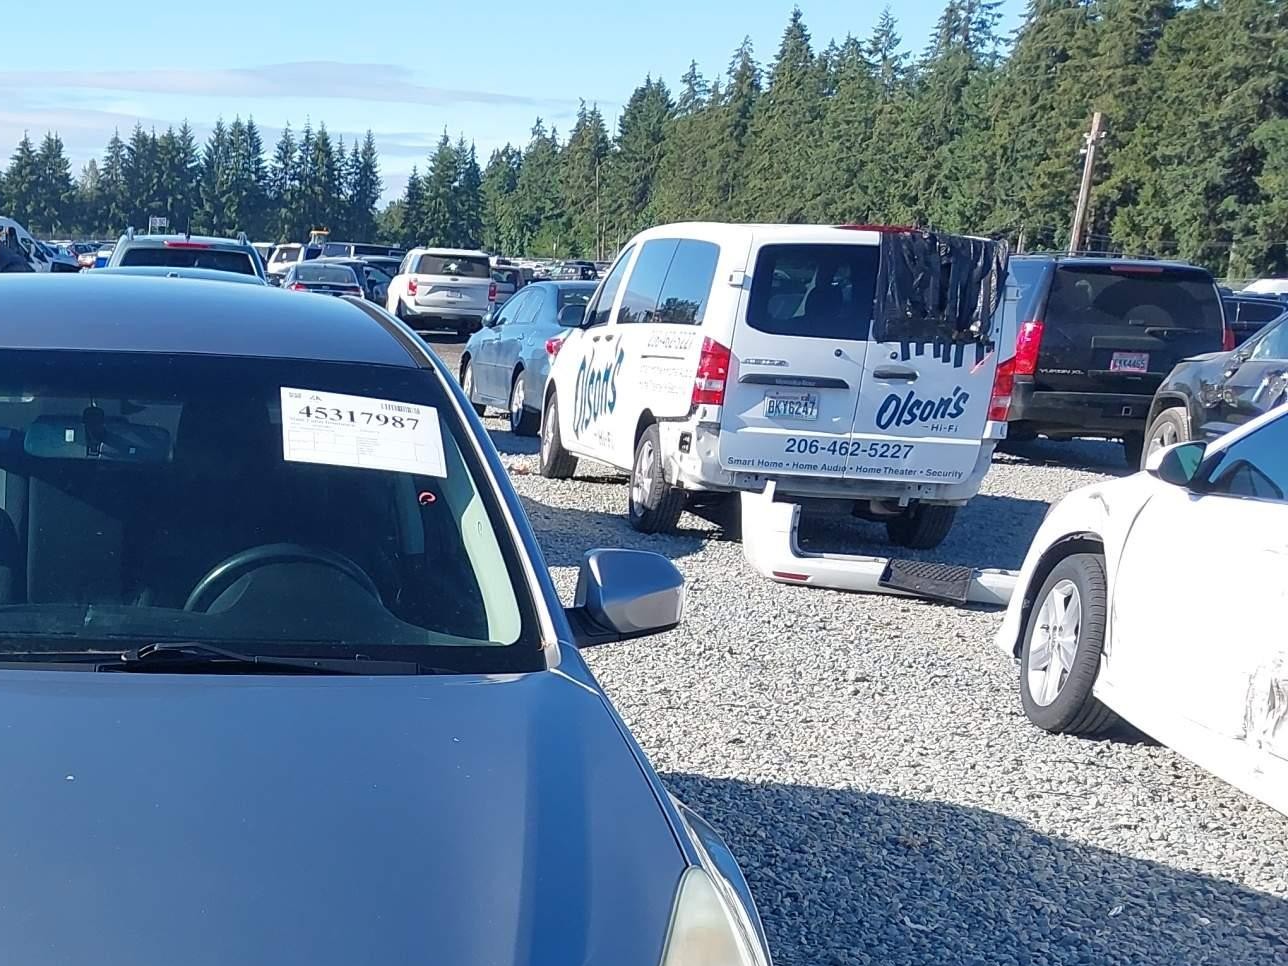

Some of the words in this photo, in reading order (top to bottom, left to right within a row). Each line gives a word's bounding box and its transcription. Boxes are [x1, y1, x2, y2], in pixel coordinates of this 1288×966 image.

[298, 405, 420, 431] 45317987
[767, 399, 816, 416] BKY6247
[875, 385, 970, 431] Olson's
[930, 423, 959, 433] Hi-Fi
[784, 437, 915, 460] 206-462-5227
[727, 456, 755, 467] Smart
[757, 458, 784, 468] Home
[792, 461, 818, 471] Home
[820, 462, 847, 473] Audio
[855, 464, 882, 474] Home
[882, 465, 918, 476] Theater
[925, 468, 964, 479] Security
